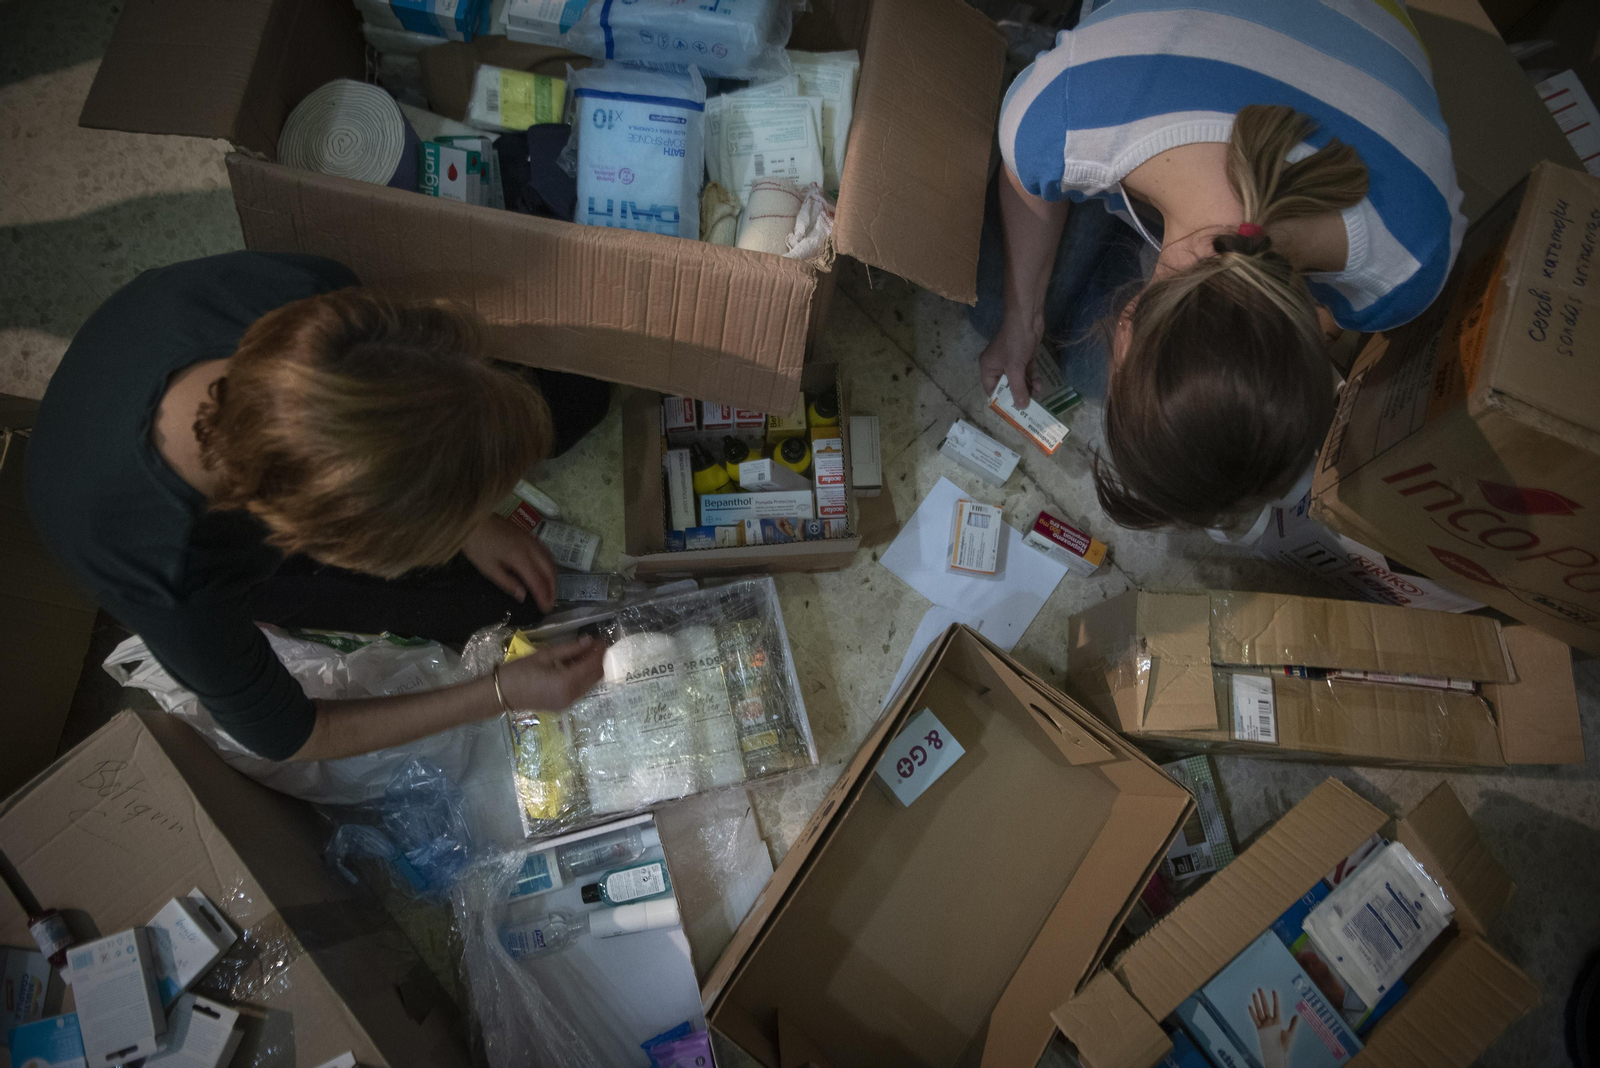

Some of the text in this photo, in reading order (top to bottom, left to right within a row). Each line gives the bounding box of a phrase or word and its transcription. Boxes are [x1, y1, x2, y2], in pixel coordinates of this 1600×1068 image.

[663, 138, 685, 148] SOAP
[664, 147, 685, 157] BATH
[1019, 410, 1028, 418] 10
[1026, 416, 1046, 433] Pharma
[1026, 424, 1055, 448] Prednisona
[704, 495, 751, 509] Bepanthol
[1038, 517, 1088, 549] Normon 500 mg
[1051, 532, 1085, 554] Naproxeno
[922, 728, 946, 752] &
